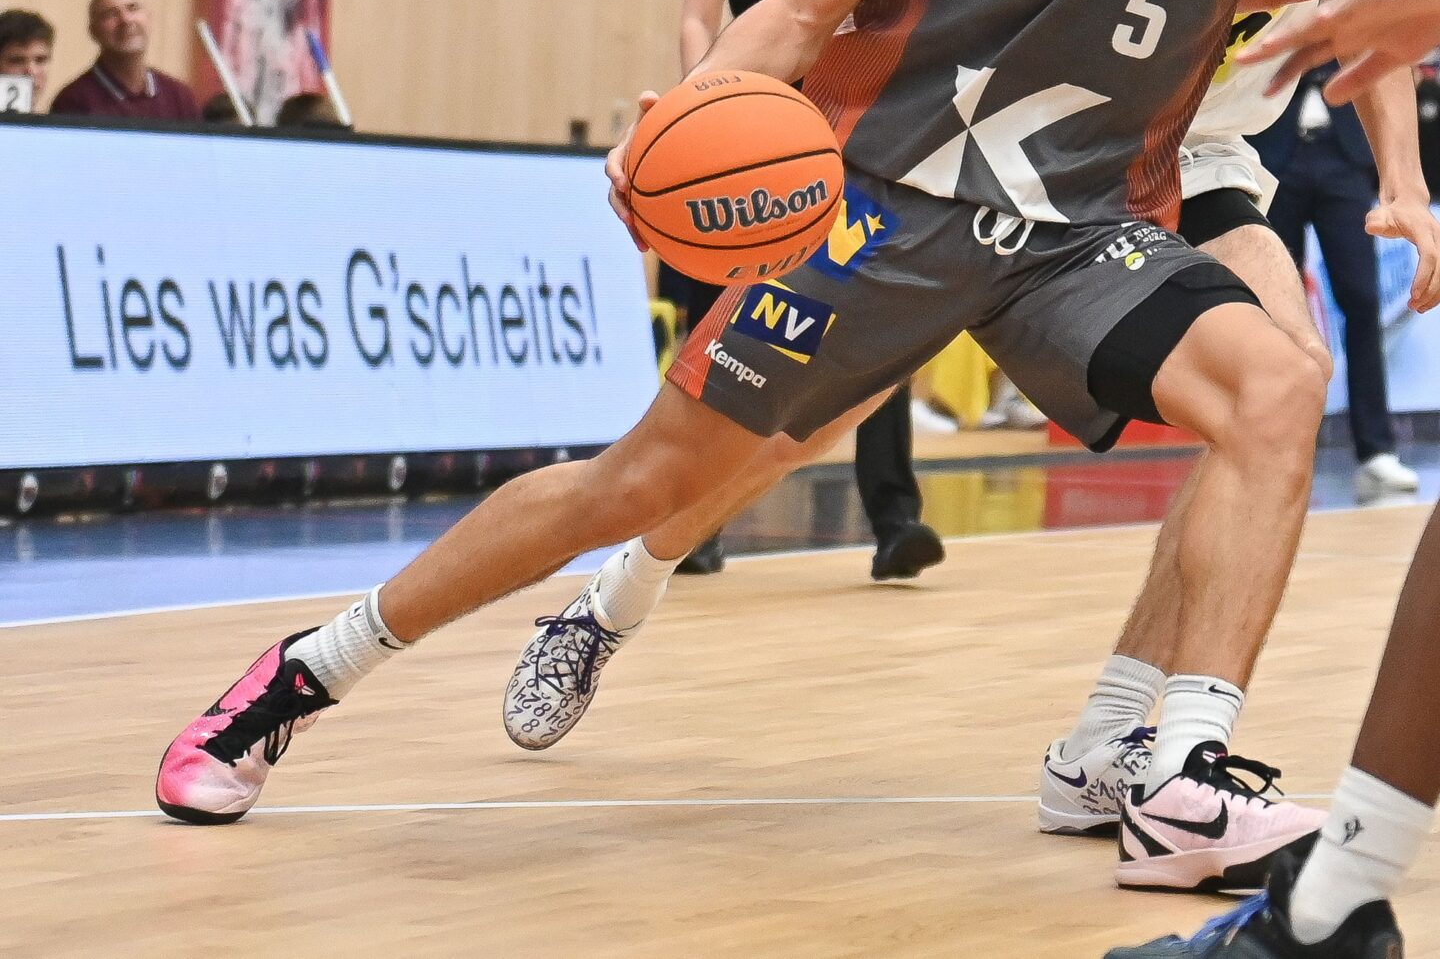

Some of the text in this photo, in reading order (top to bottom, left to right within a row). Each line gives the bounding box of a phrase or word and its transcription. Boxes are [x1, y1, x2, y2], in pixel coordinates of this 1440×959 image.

[686, 179, 829, 234] Wilson
[56, 243, 602, 372] Lies was G'scheits!
[750, 292, 816, 342] NV
[704, 338, 768, 389] Kempa
